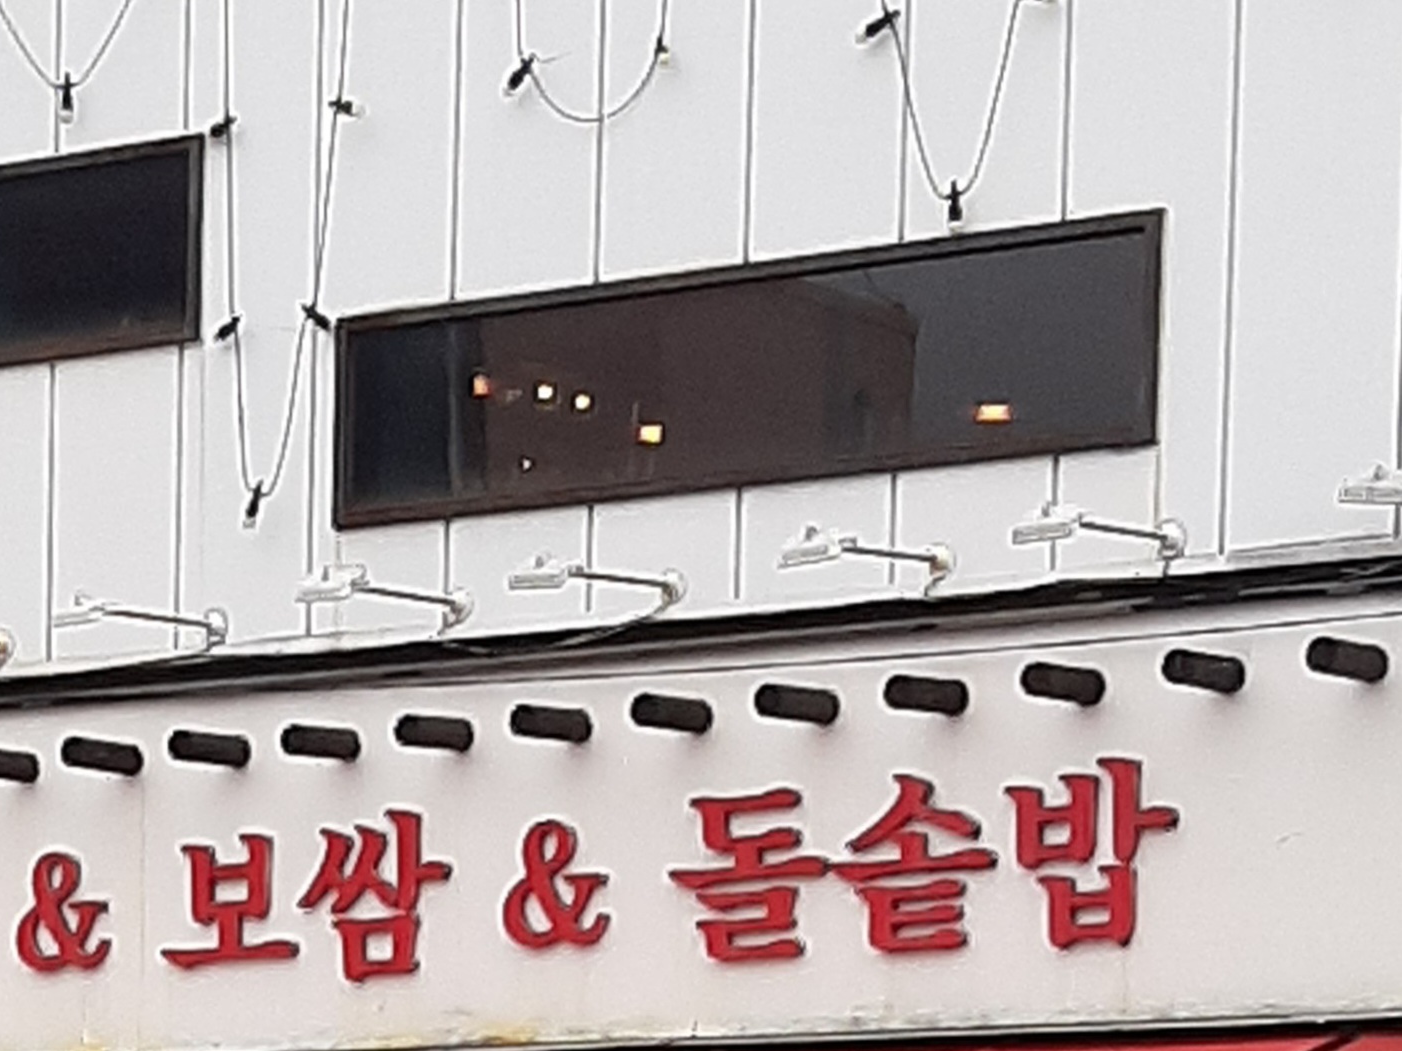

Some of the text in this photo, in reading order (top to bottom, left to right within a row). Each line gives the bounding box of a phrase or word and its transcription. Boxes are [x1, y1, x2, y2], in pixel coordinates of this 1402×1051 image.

[16, 851, 112, 973] &
[160, 807, 452, 977] 보쌈
[502, 819, 612, 951] &
[668, 756, 1181, 963] 돌솥밥
